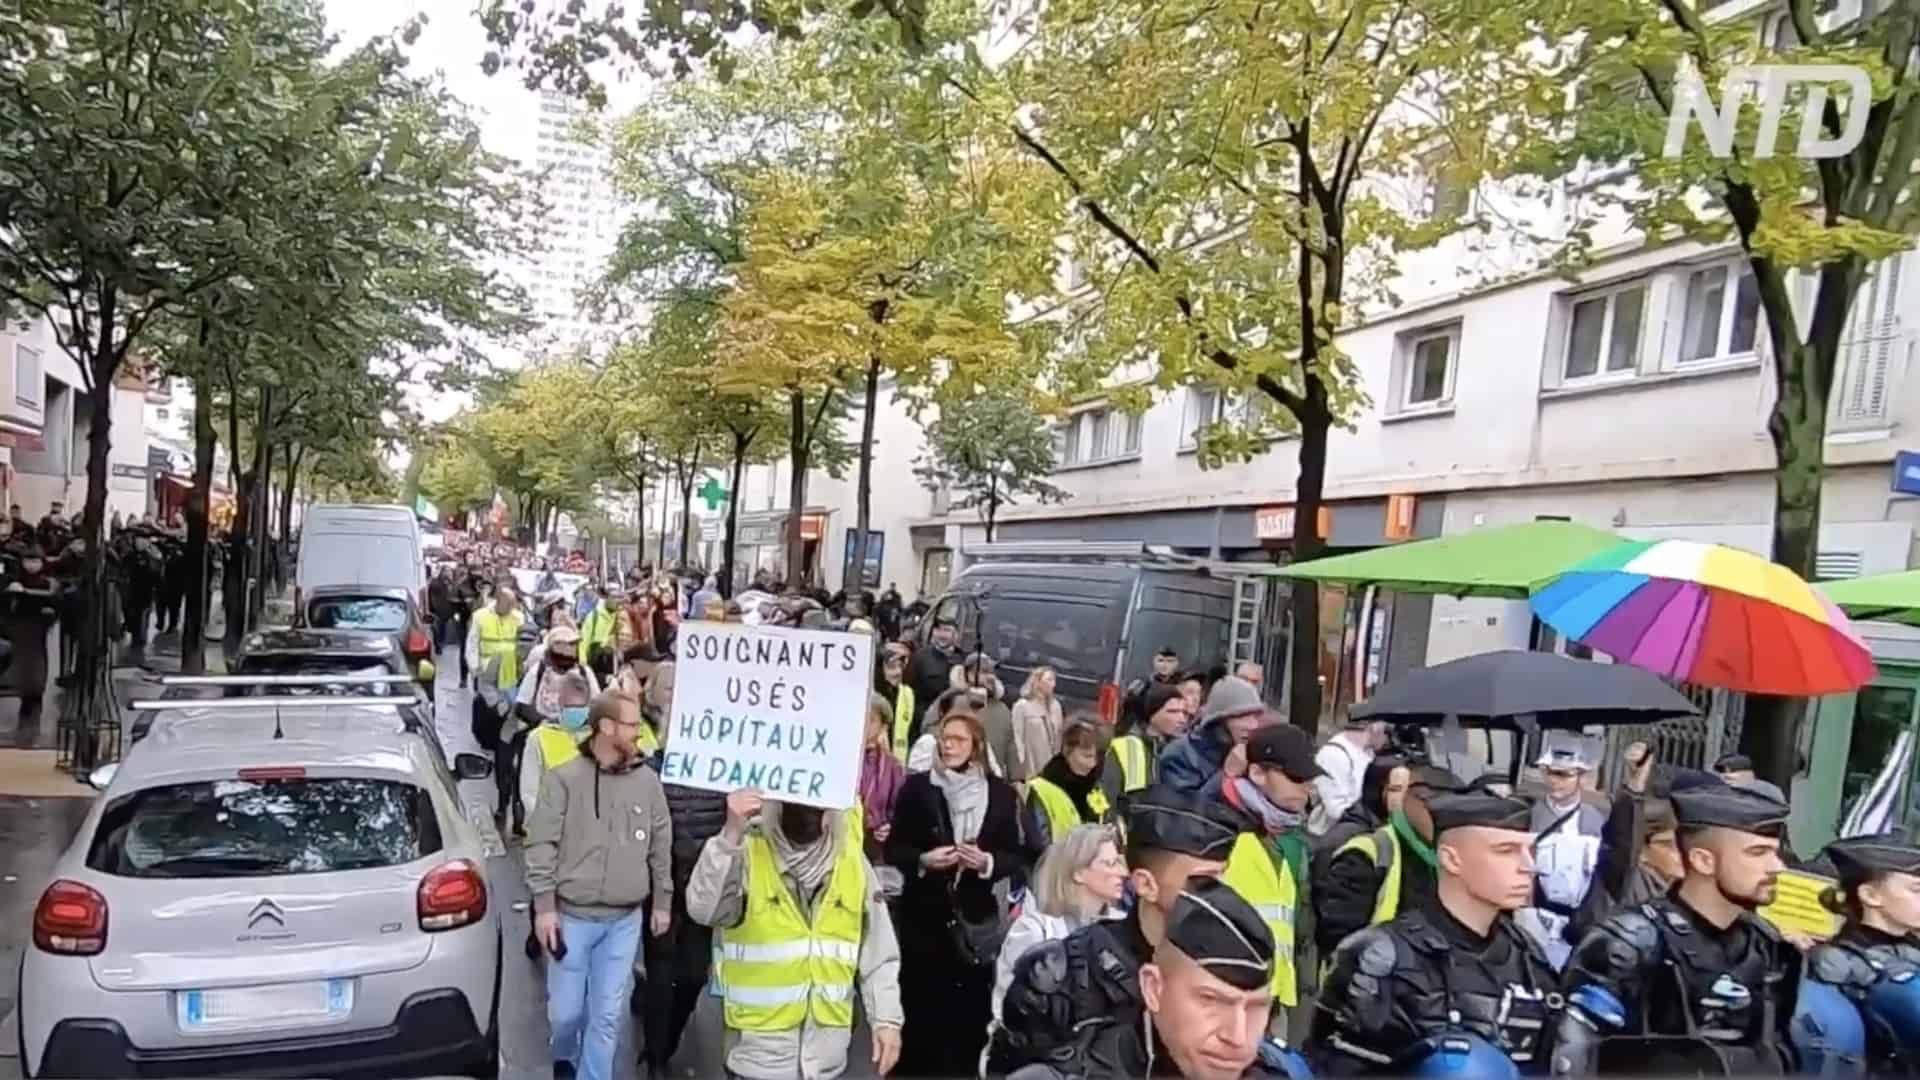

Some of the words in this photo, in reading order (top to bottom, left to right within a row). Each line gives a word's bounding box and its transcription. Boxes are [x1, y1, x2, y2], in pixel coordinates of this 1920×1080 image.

[685, 633, 857, 671] SOIGNANTS
[726, 676, 807, 711] USÉS
[679, 708, 829, 755] HÔPITAUX
[663, 752, 698, 778] EN
[708, 757, 826, 798] DANGER
